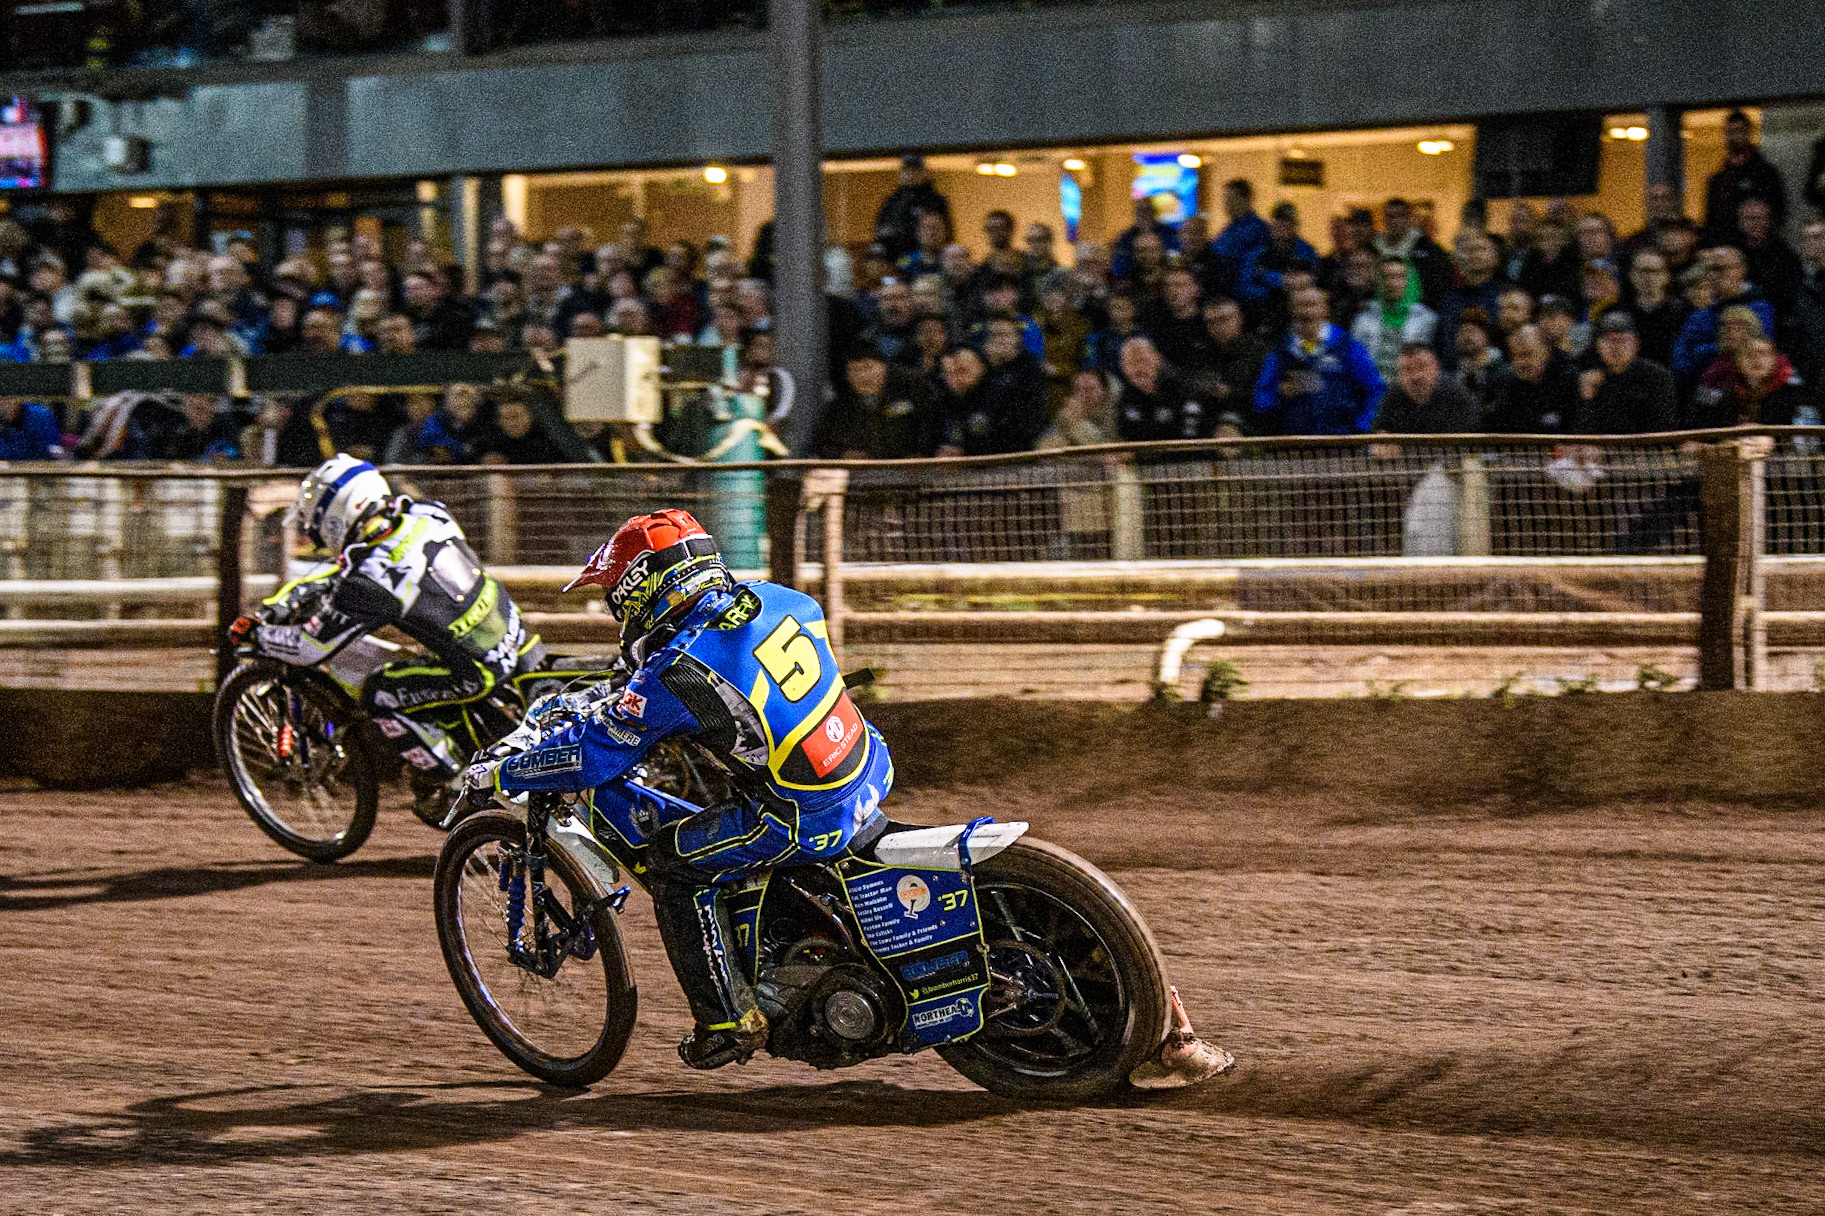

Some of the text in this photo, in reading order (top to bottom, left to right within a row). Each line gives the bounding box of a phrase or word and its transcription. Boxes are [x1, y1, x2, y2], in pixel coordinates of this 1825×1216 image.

[611, 559, 649, 605] OAKLEY
[753, 615, 822, 702] 5
[822, 748, 842, 767] ERIC
[840, 723, 858, 750] STEAD
